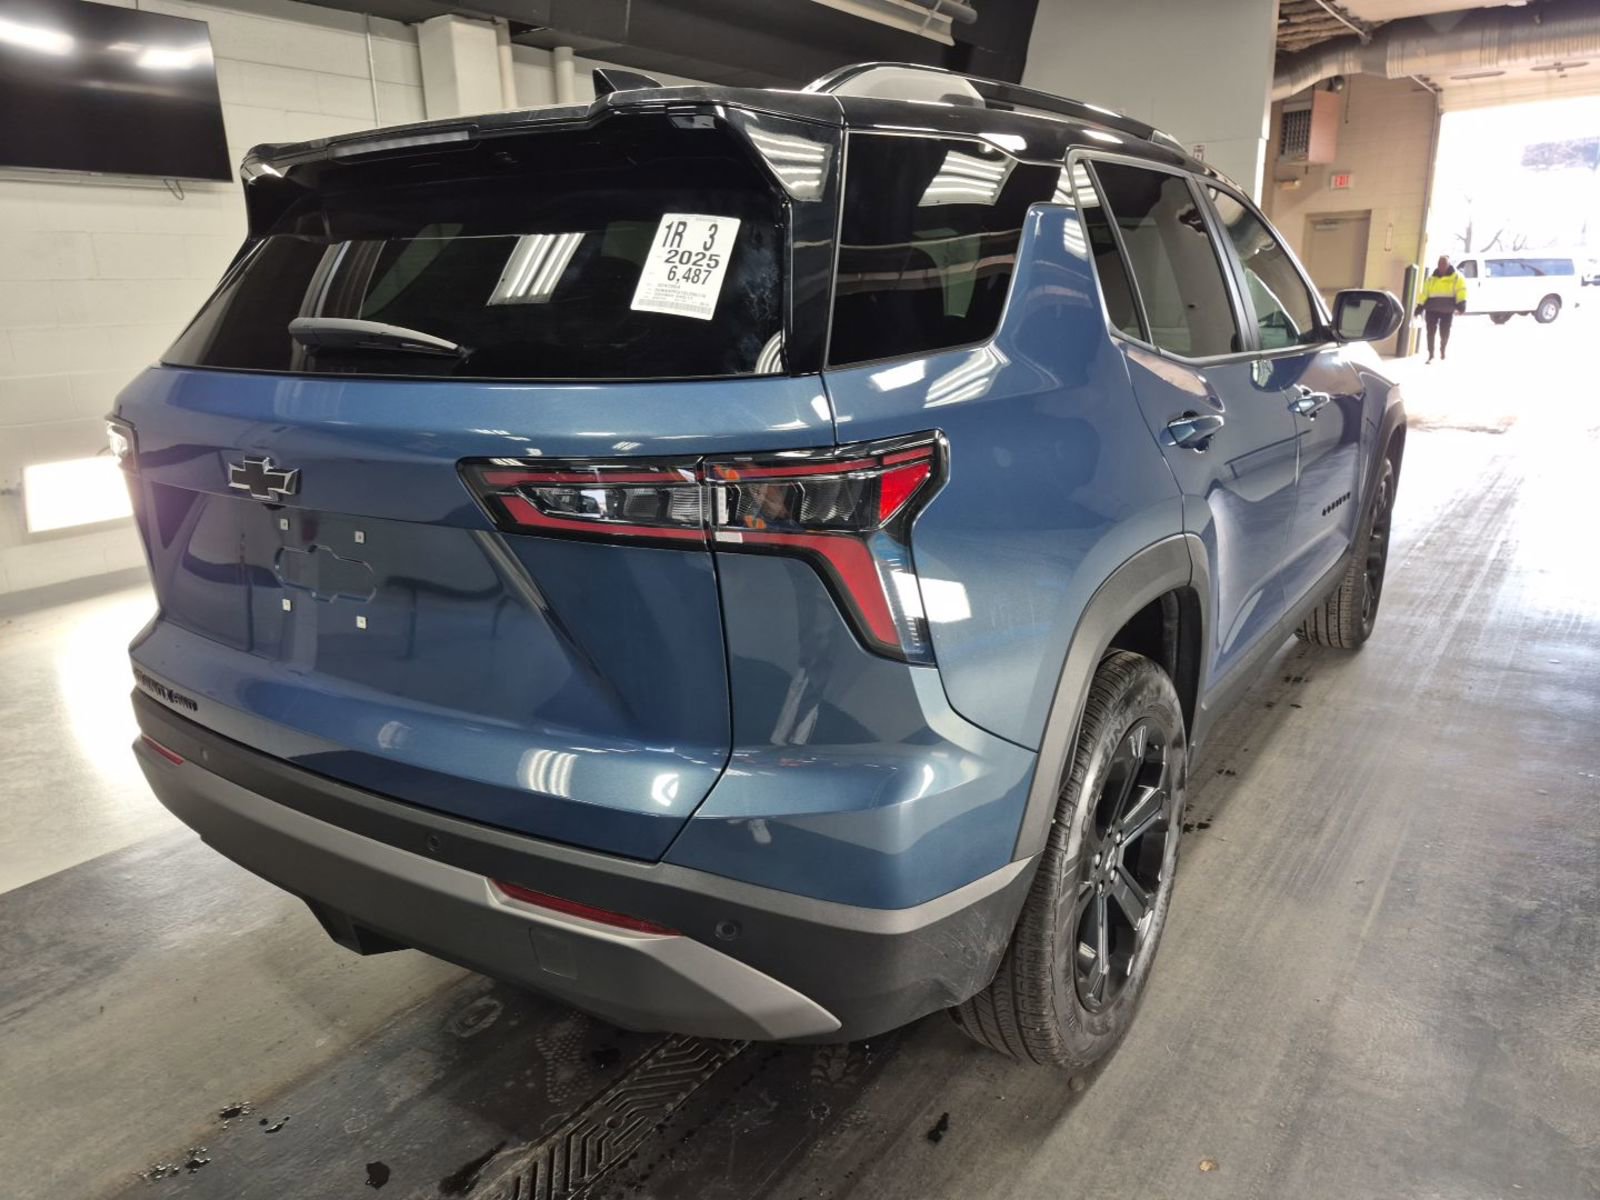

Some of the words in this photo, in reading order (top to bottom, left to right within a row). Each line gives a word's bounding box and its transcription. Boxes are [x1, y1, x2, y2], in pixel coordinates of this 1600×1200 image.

[662, 221, 688, 248] 1R
[703, 223, 719, 251] 3
[664, 250, 720, 269] 2025
[667, 265, 712, 285] 6,487
